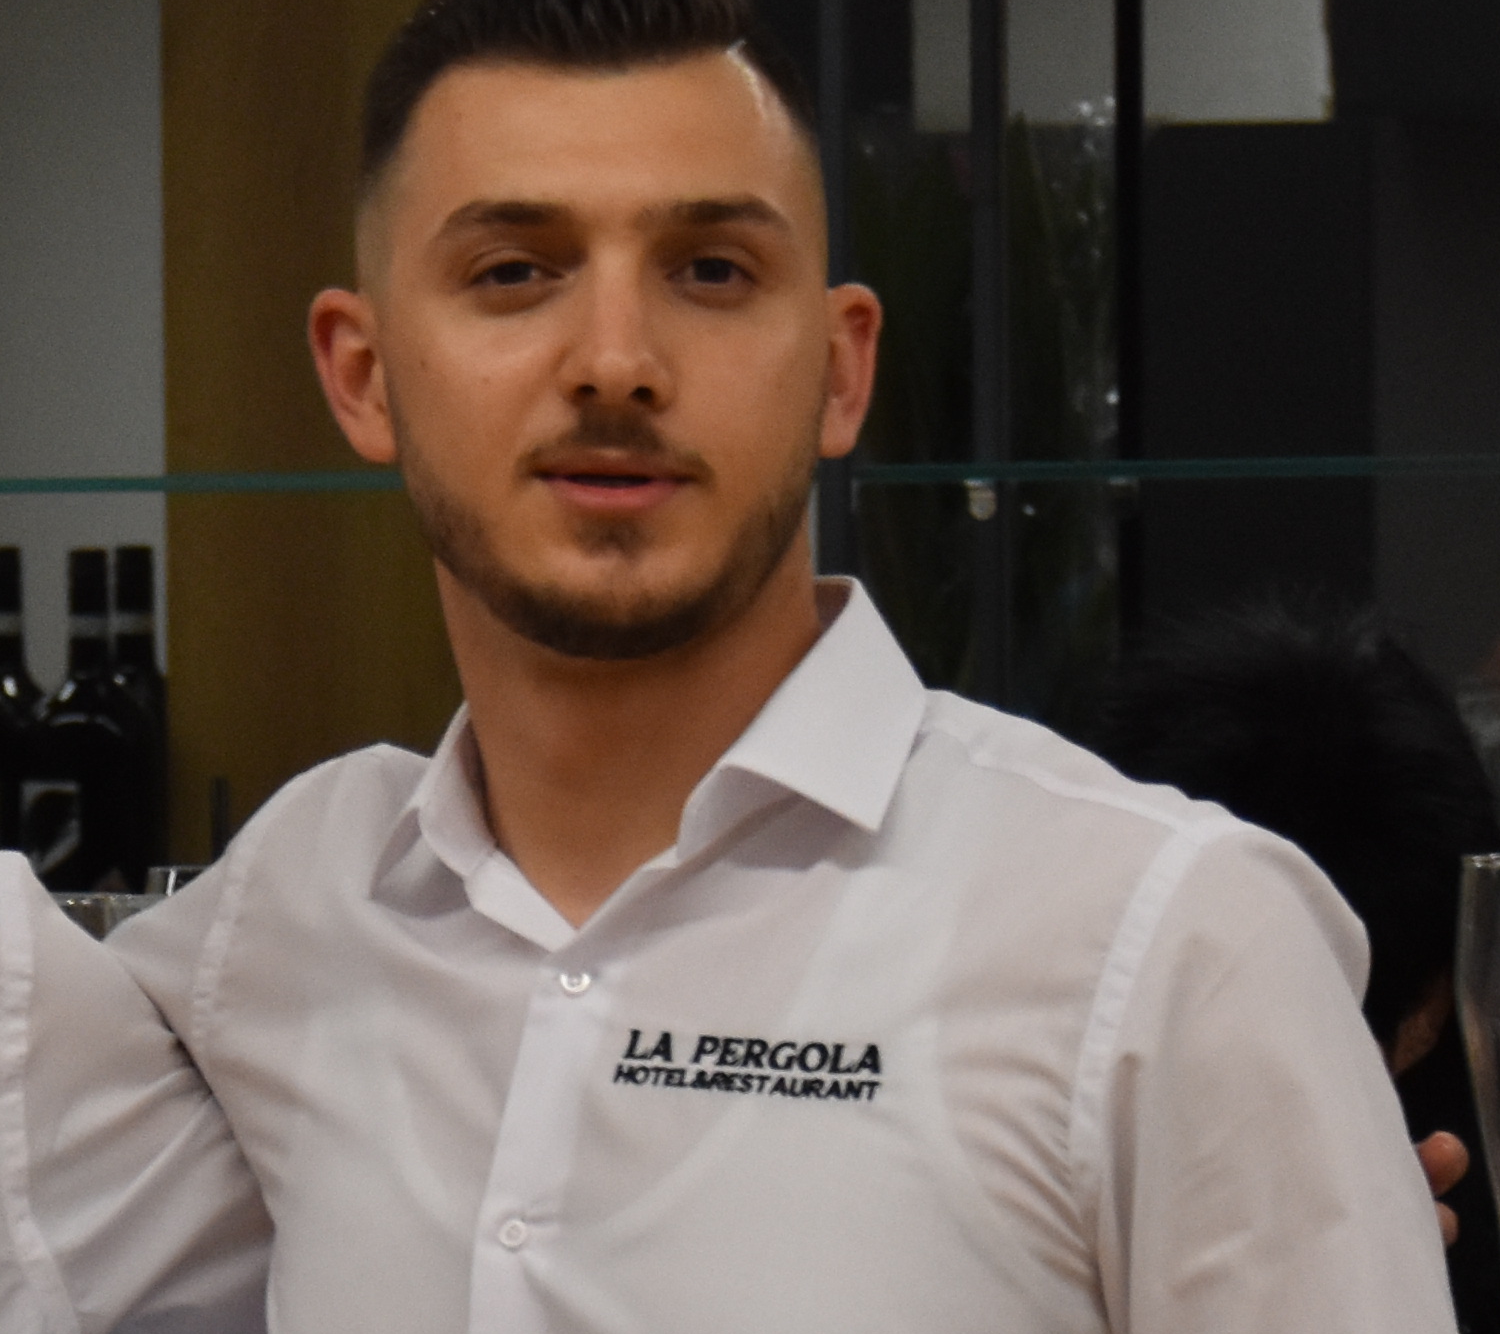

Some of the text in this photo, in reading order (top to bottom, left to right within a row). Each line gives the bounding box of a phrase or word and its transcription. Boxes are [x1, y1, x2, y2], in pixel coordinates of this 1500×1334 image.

[623, 1029, 883, 1075] LA PERGOLA
[613, 1062, 882, 1103] HOTEL&RESTAURANT
